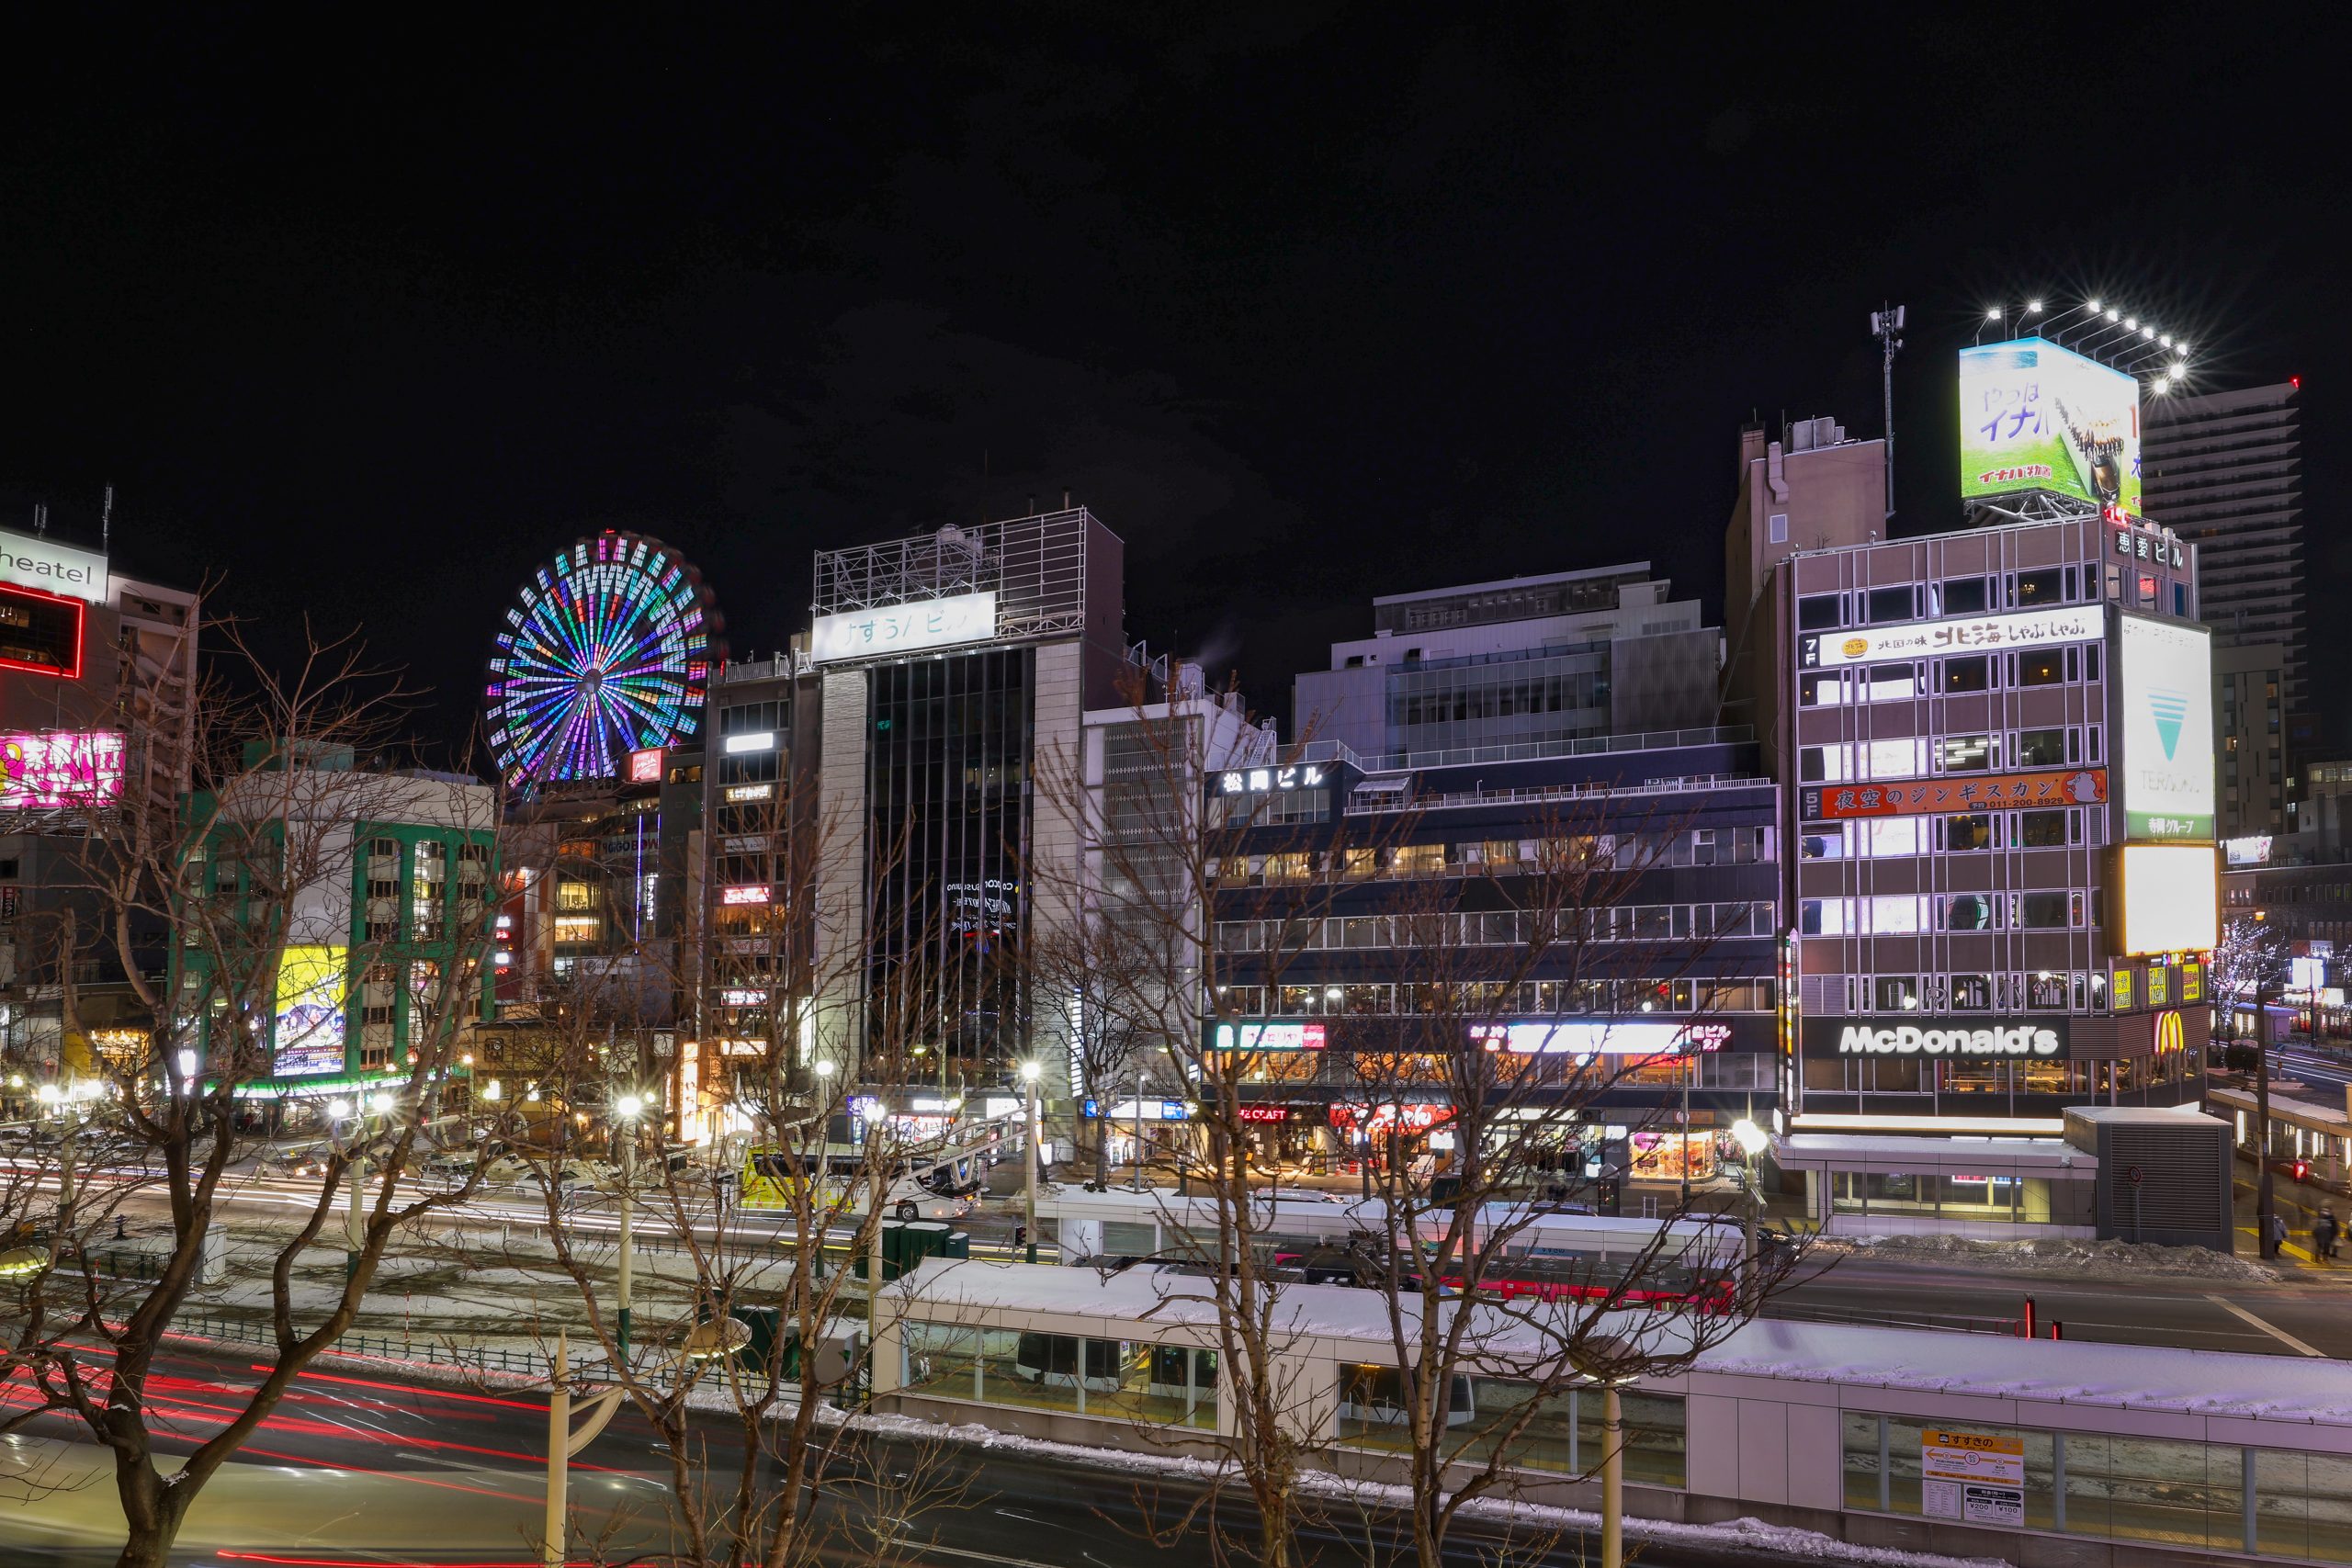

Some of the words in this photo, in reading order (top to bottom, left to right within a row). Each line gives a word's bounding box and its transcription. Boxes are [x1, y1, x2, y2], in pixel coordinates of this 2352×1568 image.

[1979, 465, 2052, 484] イナバ物置
[2117, 532, 2183, 569] 恵愛ビル
[1878, 636, 1928, 650] 北国の味
[1805, 639, 1817, 666] 7F
[1837, 780, 2056, 811] 夜空のジンギスカン
[1989, 796, 2064, 808] 011-200-8929
[1805, 792, 1818, 817] 5F
[1691, 1025, 1732, 1039] 当ビル
[1702, 1039, 1723, 1050] 2F
[1838, 1025, 2059, 1055] McDonald's
[1251, 1110, 1285, 1120] CRAFT
[1352, 1104, 1432, 1129] っちゃん
[1951, 1435, 1994, 1448] すすきの
[1970, 1502, 1989, 1511] ¥200
[1998, 1506, 2018, 1514] ¥100
